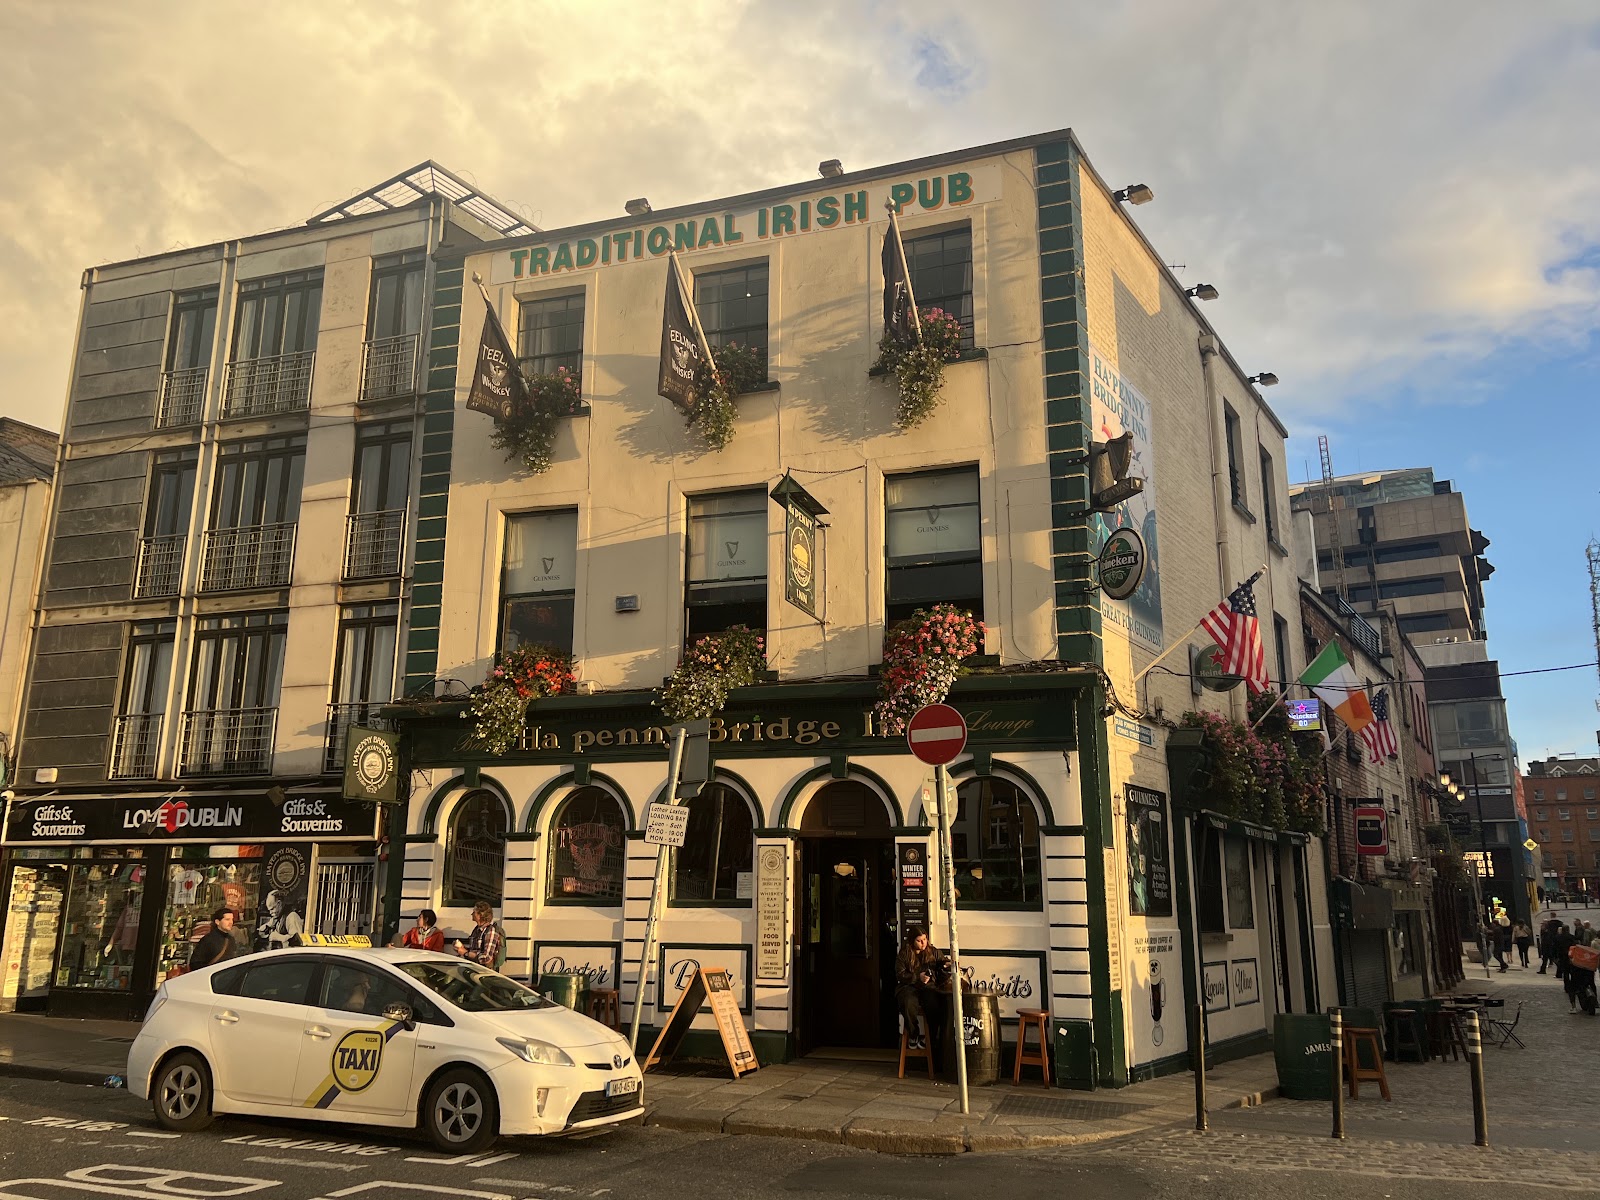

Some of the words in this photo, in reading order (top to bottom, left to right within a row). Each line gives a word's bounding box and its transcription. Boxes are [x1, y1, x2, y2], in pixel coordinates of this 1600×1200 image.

[510, 214, 744, 278] TRADITIONAL
[757, 189, 870, 239] IRISH
[892, 171, 975, 213] PUB
[669, 326, 698, 359] EELING
[671, 357, 695, 381] WHISKEY
[482, 374, 511, 397] WHISKEY
[1093, 354, 1145, 421] HA'PENNY
[1093, 376, 1130, 428] BRIDGE
[1131, 415, 1147, 444] INN
[917, 524, 949, 534] GUINNESS
[717, 558, 746, 567] GUINNESS
[1101, 552, 1136, 573] eineken
[533, 575, 560, 583] GUINNESS
[796, 588, 808, 604] INN
[1102, 601, 1122, 627] GREAT
[1121, 613, 1135, 634] FOR
[1134, 620, 1161, 648] GUINNESS
[517, 725, 561, 751] Ha
[708, 716, 841, 745] Bridge
[964, 709, 1036, 737] Lounge
[373, 735, 392, 757] BRIDGE
[1129, 788, 1160, 807] GUINNESS
[175, 800, 243, 828] DUBLIN
[280, 814, 343, 833] Souvenirs
[650, 812, 674, 821] LOADING
[31, 819, 86, 837] Souvenirs
[556, 822, 622, 849] TEELING
[649, 834, 664, 842] MON
[668, 836, 680, 844] SAT
[902, 864, 924, 872] WINTER
[325, 935, 347, 944] TAXI
[1134, 937, 1144, 946] ENJOY
[1149, 936, 1158, 945] IRISH
[1157, 936, 1168, 944] COFFEE
[1147, 945, 1156, 953] PENNY
[1156, 945, 1168, 953] BRIDGE
[338, 1047, 378, 1071] TAXI
[1304, 1043, 1332, 1055] JAMES
[221, 1134, 401, 1157] LOADING
